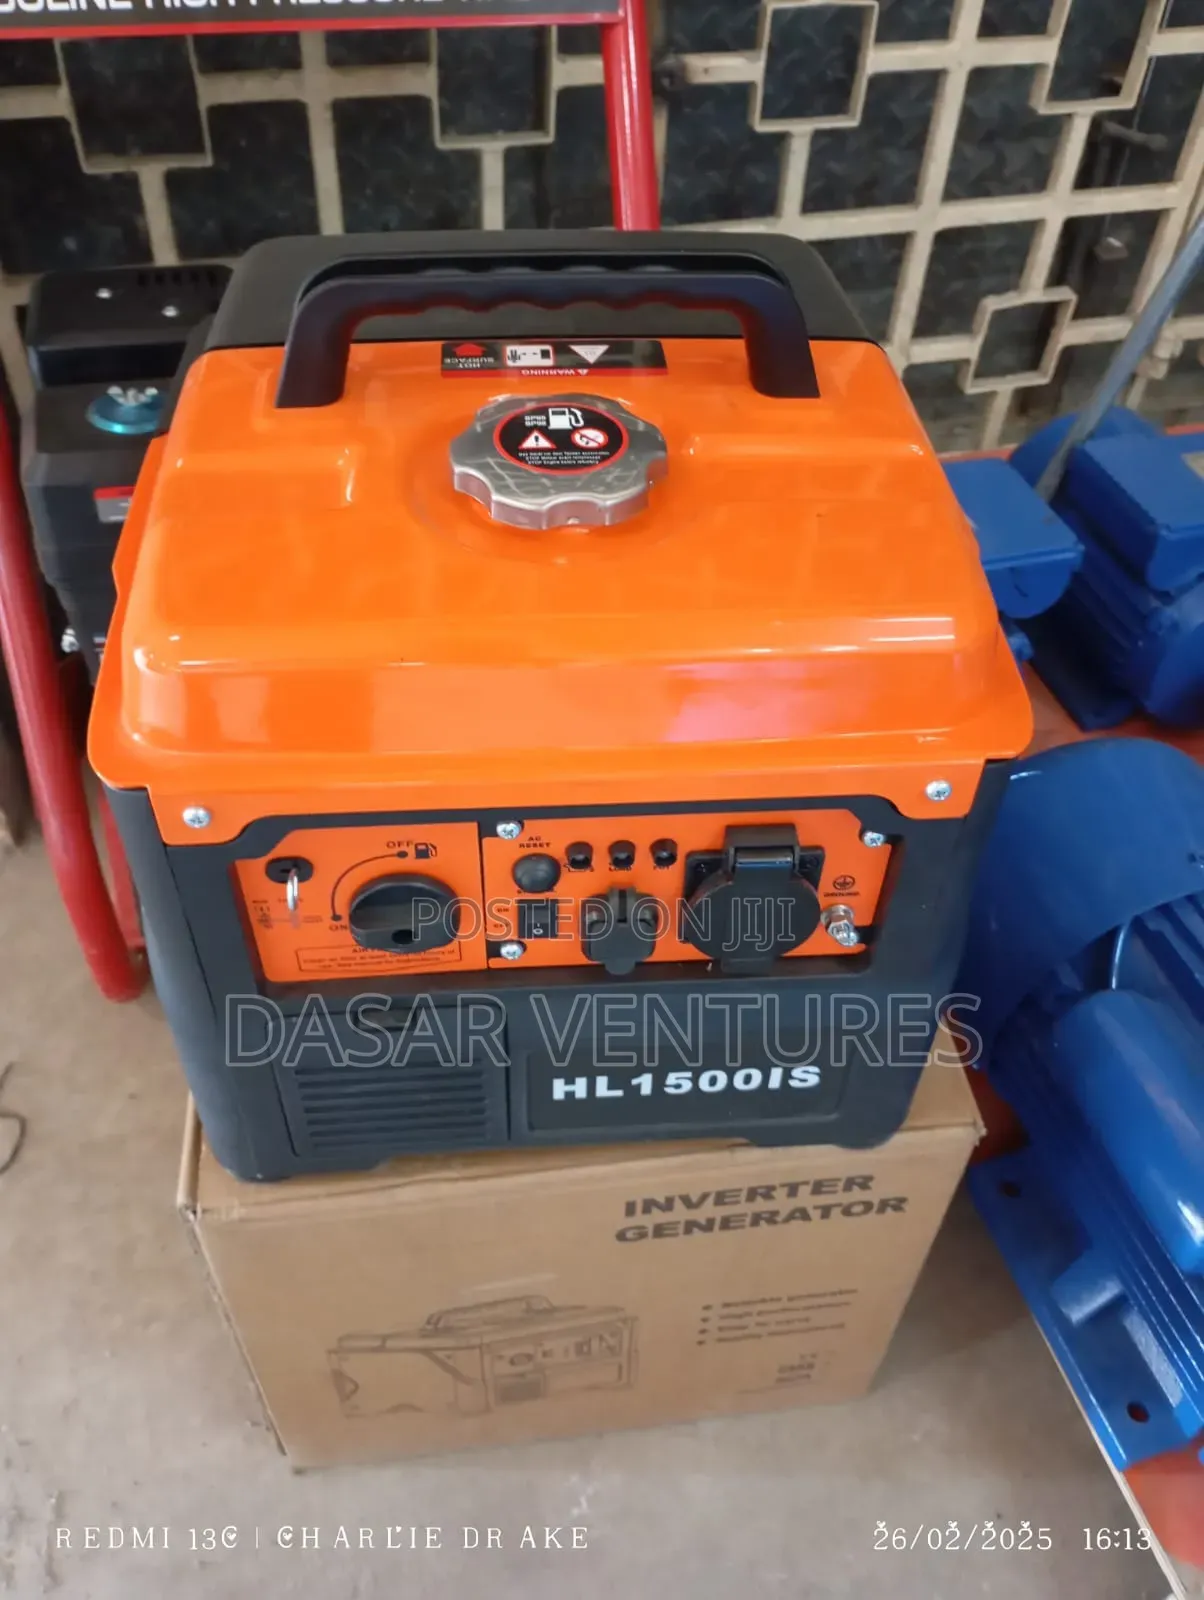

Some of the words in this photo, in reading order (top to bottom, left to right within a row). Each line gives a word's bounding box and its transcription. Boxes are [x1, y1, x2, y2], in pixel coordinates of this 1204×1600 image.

[386, 840, 414, 849] OFF
[552, 1065, 821, 1101] HL1500IS
[624, 1175, 875, 1218] INVERTER
[615, 1197, 909, 1242] GENERATOR
